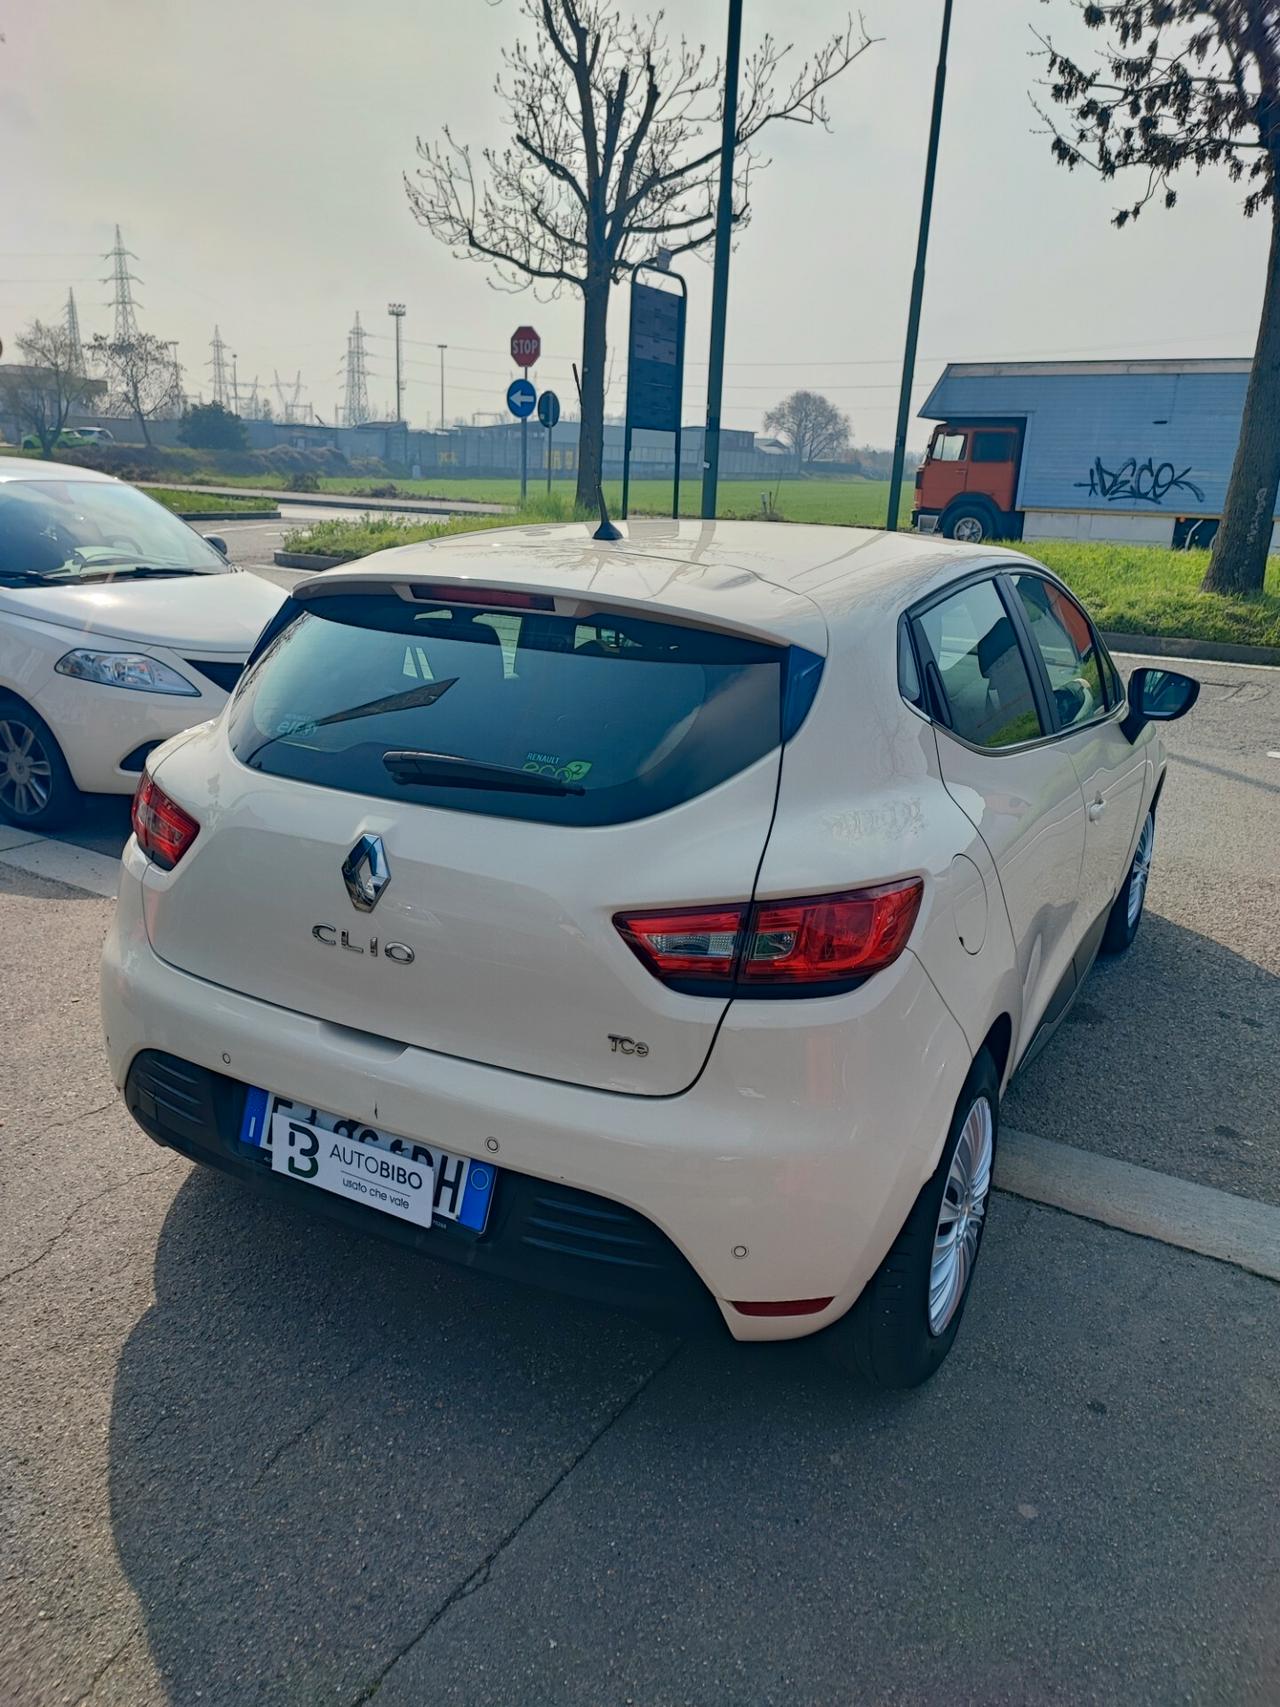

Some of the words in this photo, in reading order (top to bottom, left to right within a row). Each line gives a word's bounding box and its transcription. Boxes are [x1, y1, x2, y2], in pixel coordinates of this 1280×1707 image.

[512, 339, 538, 354] STOP
[527, 752, 560, 764] RENAULT
[311, 922, 415, 965] CLIO
[607, 1033, 650, 1057] TCe
[329, 1144, 422, 1189] AUTOBIBO
[342, 1177, 367, 1193] usato
[369, 1188, 387, 1201] che
[389, 1196, 410, 1209] vale
